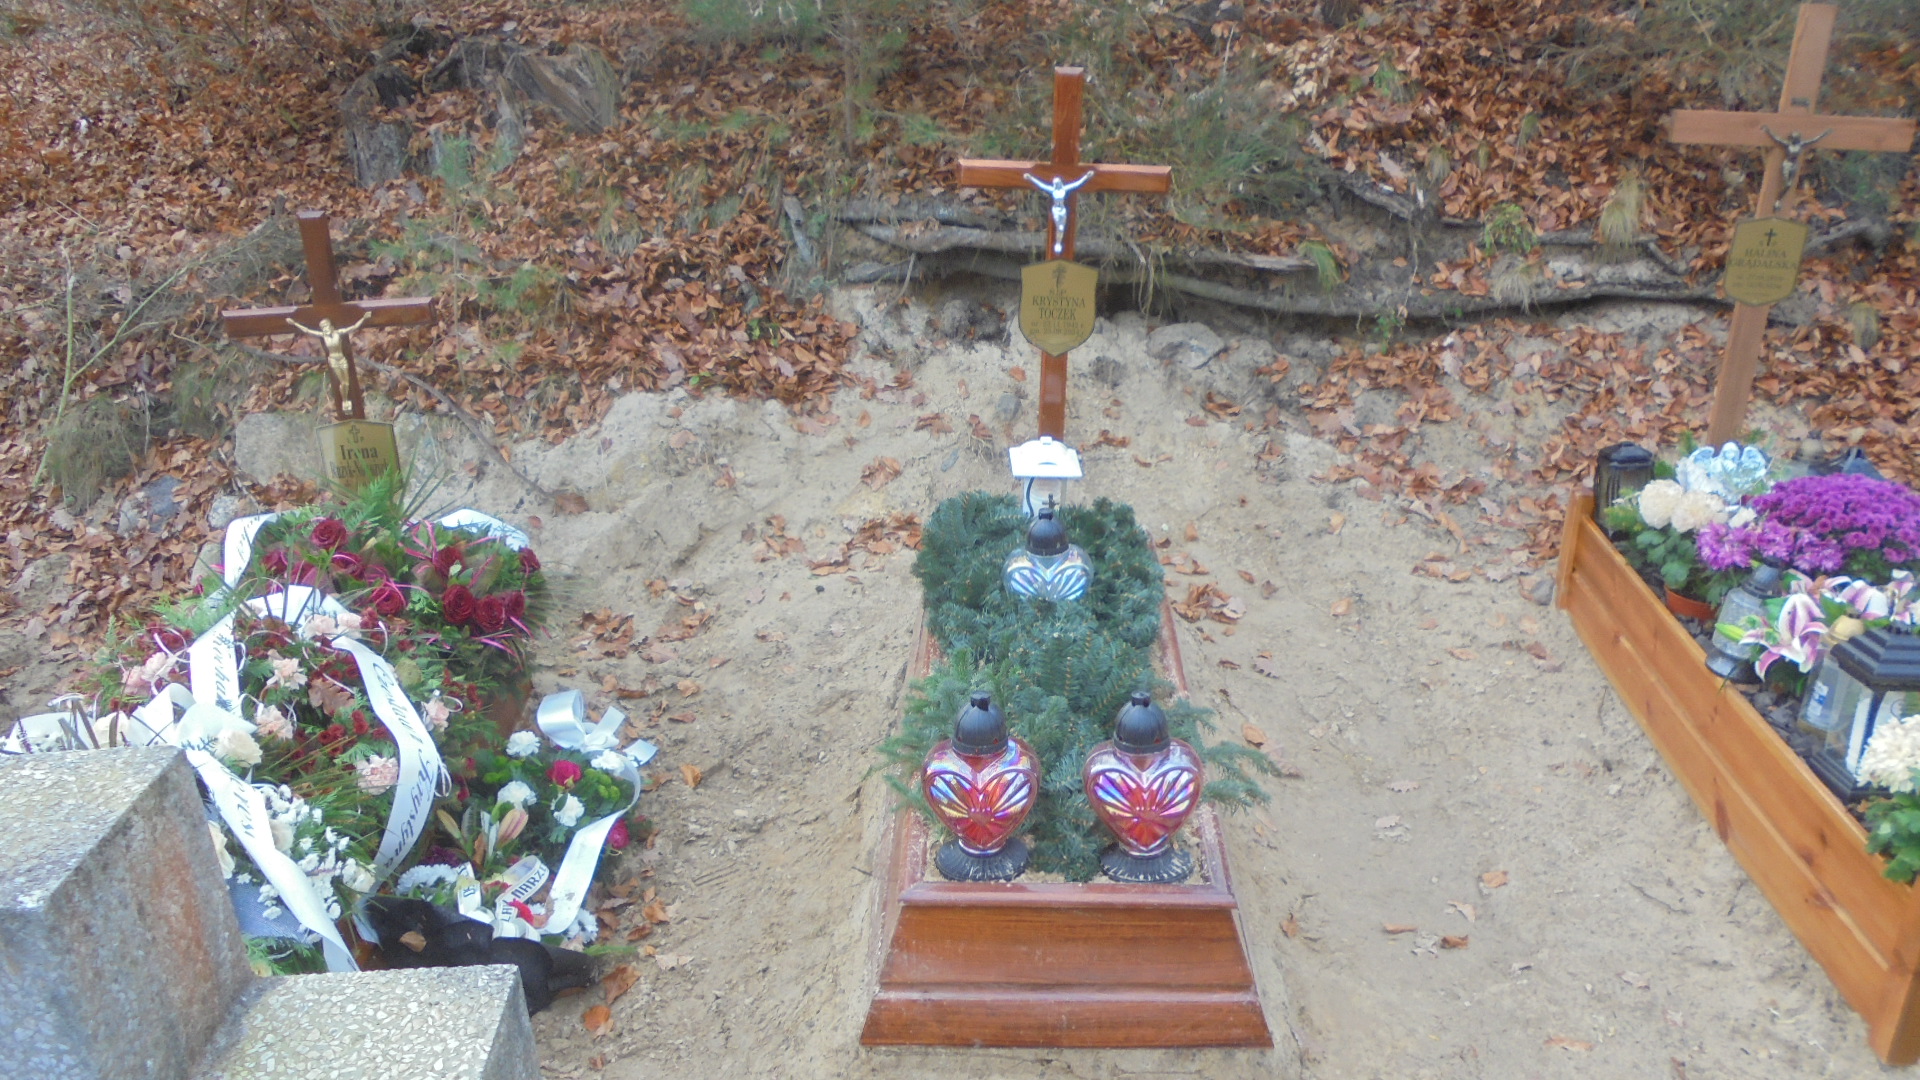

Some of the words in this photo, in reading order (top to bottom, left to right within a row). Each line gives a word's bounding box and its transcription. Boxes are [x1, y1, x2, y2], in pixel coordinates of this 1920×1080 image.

[1032, 295, 1086, 308] KRYSTYNA
[1039, 307, 1077, 321] TOCZEK
[385, 749, 434, 869] Krystyna
